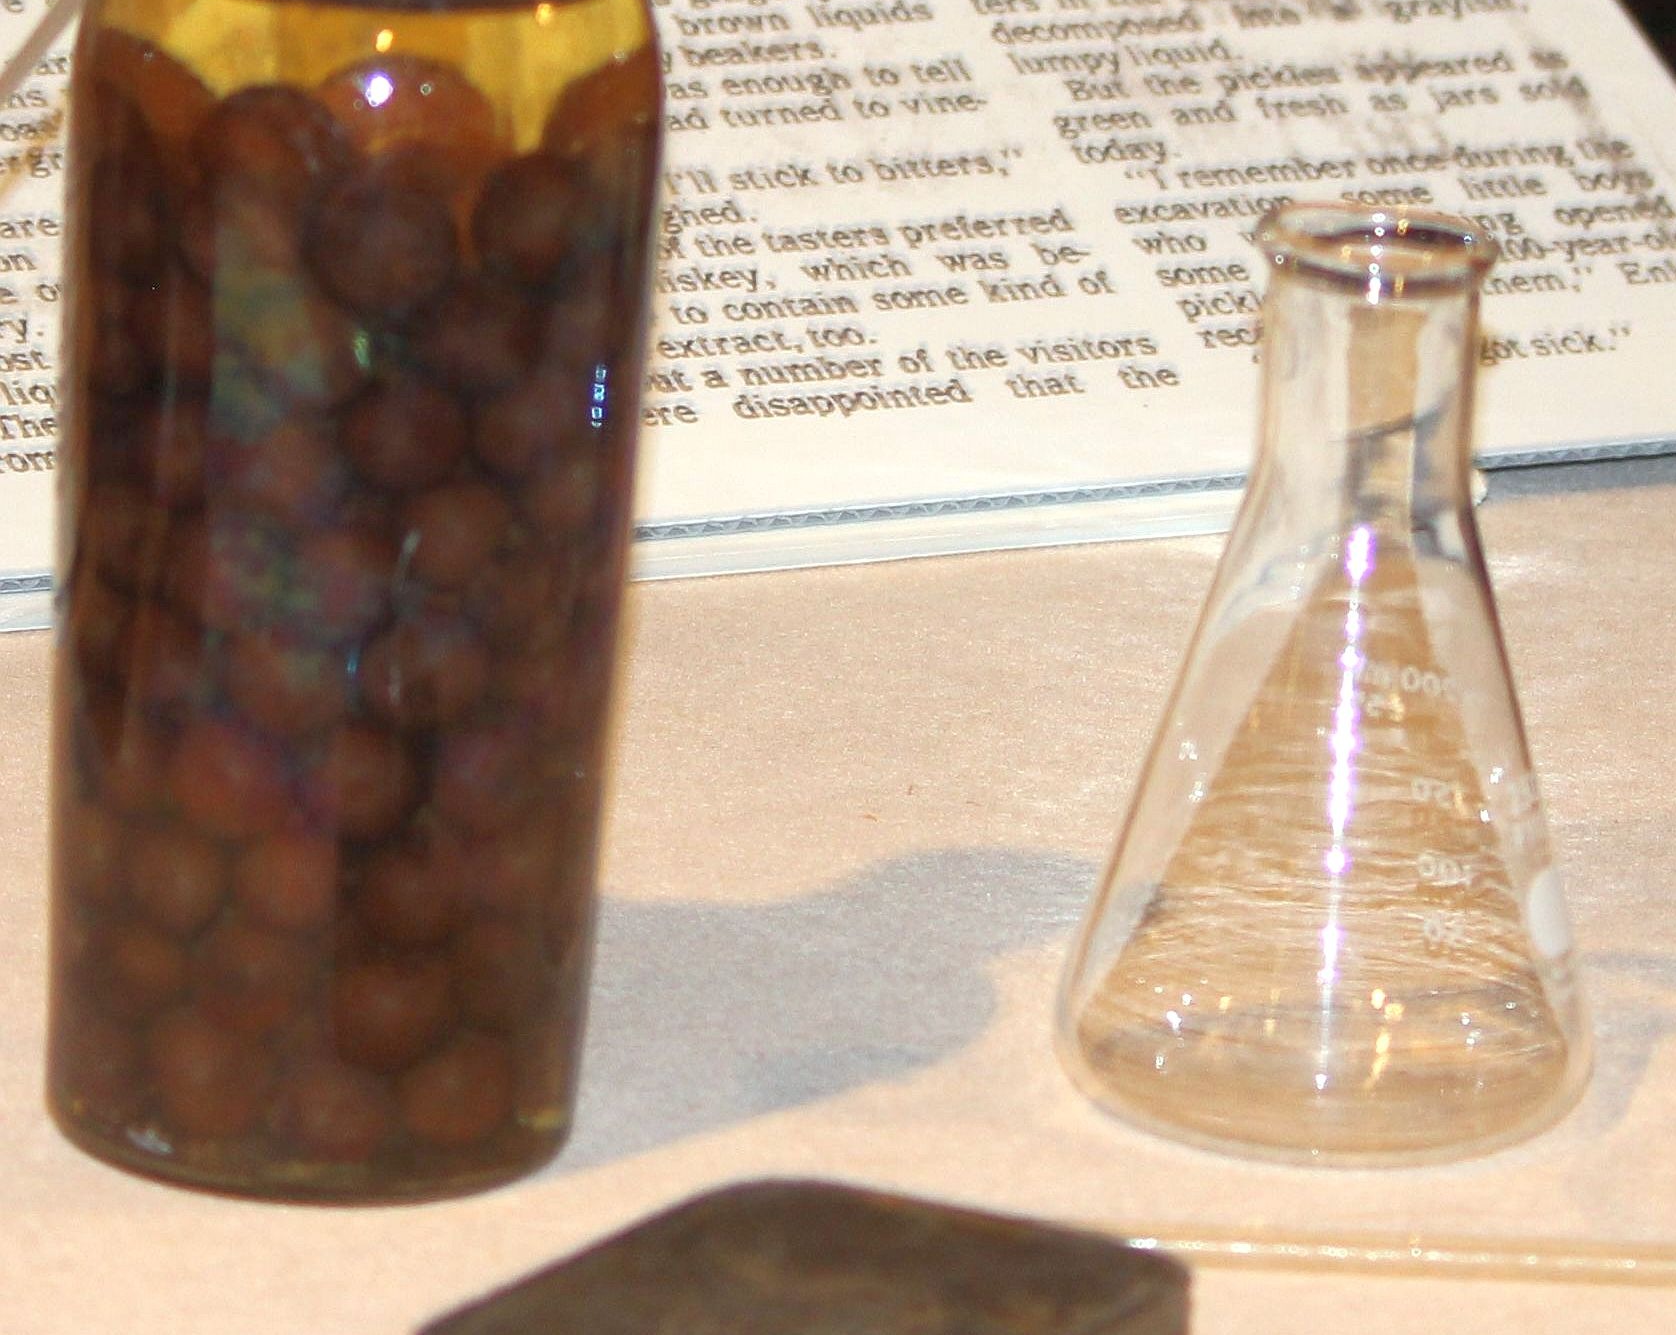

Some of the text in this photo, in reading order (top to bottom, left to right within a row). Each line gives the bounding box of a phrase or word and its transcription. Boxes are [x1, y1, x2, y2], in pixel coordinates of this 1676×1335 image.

[673, 0, 936, 37] brown liquids
[990, 8, 1206, 46] decomposed
[720, 57, 974, 97] enough to tell
[1006, 49, 1120, 75] lumpy
[1064, 77, 1133, 102] But
[1142, 72, 1203, 98] the
[719, 89, 988, 129] turned to vine-
[1053, 109, 1153, 140] green
[1170, 98, 1239, 127] and
[1254, 92, 1352, 121] fresh
[1369, 92, 1409, 112] as
[1071, 137, 1181, 166] today.
[729, 163, 821, 191] stick
[826, 161, 865, 185] to
[1176, 153, 1356, 189] remember
[1366, 152, 1448, 175] once
[1457, 173, 1549, 201] little
[694, 234, 756, 258] the
[761, 222, 891, 254] tasters
[897, 206, 1077, 249] preferred
[1132, 231, 1209, 256] who
[800, 240, 1091, 283] which was be-
[1156, 263, 1250, 288] some
[669, 268, 1119, 325] to contain some kind of
[655, 325, 879, 360] extract, too.
[700, 335, 1159, 389] a number of the visitors
[731, 364, 1182, 420] disappointed that the
